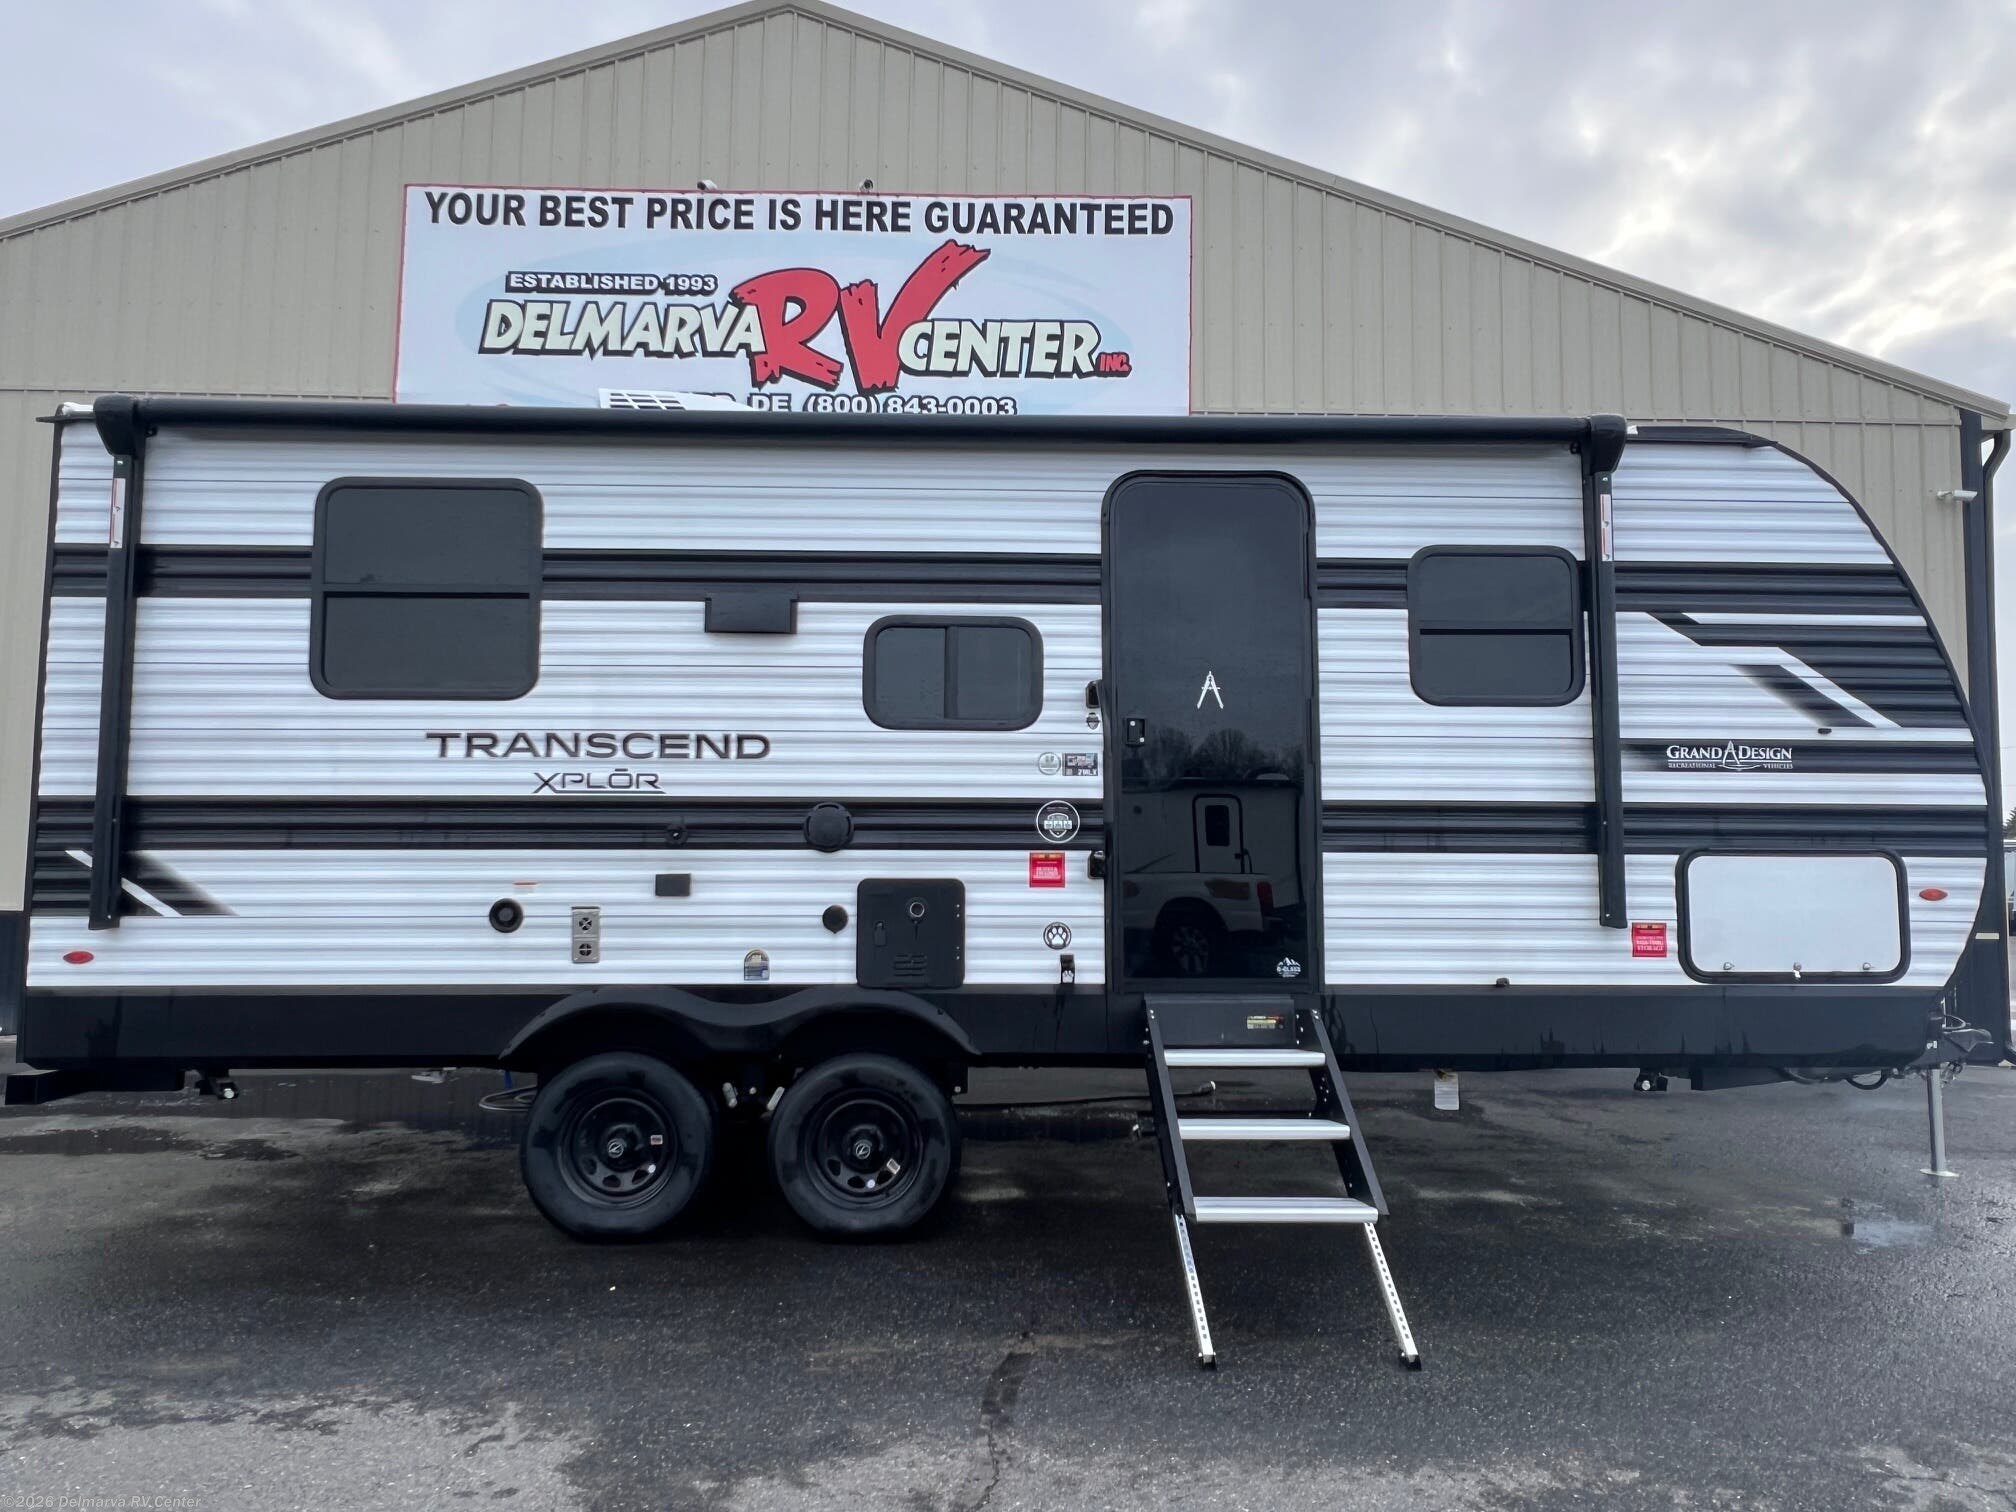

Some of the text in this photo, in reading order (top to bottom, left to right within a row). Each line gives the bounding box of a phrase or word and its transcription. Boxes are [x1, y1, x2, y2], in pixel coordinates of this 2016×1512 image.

[425, 191, 1174, 235] YOUR BEST PRICE IS HERE GUARANTEED
[507, 272, 717, 294] ESTABLISHED 1993
[479, 299, 768, 359] DELMARVA
[728, 239, 991, 396] RV
[898, 319, 1101, 379] CENTER
[804, 394, 879, 413] (800)
[883, 396, 1017, 415] 843-0003
[426, 731, 771, 760] TRANSCEND
[1666, 745, 1793, 760] GRAND DESIGN
